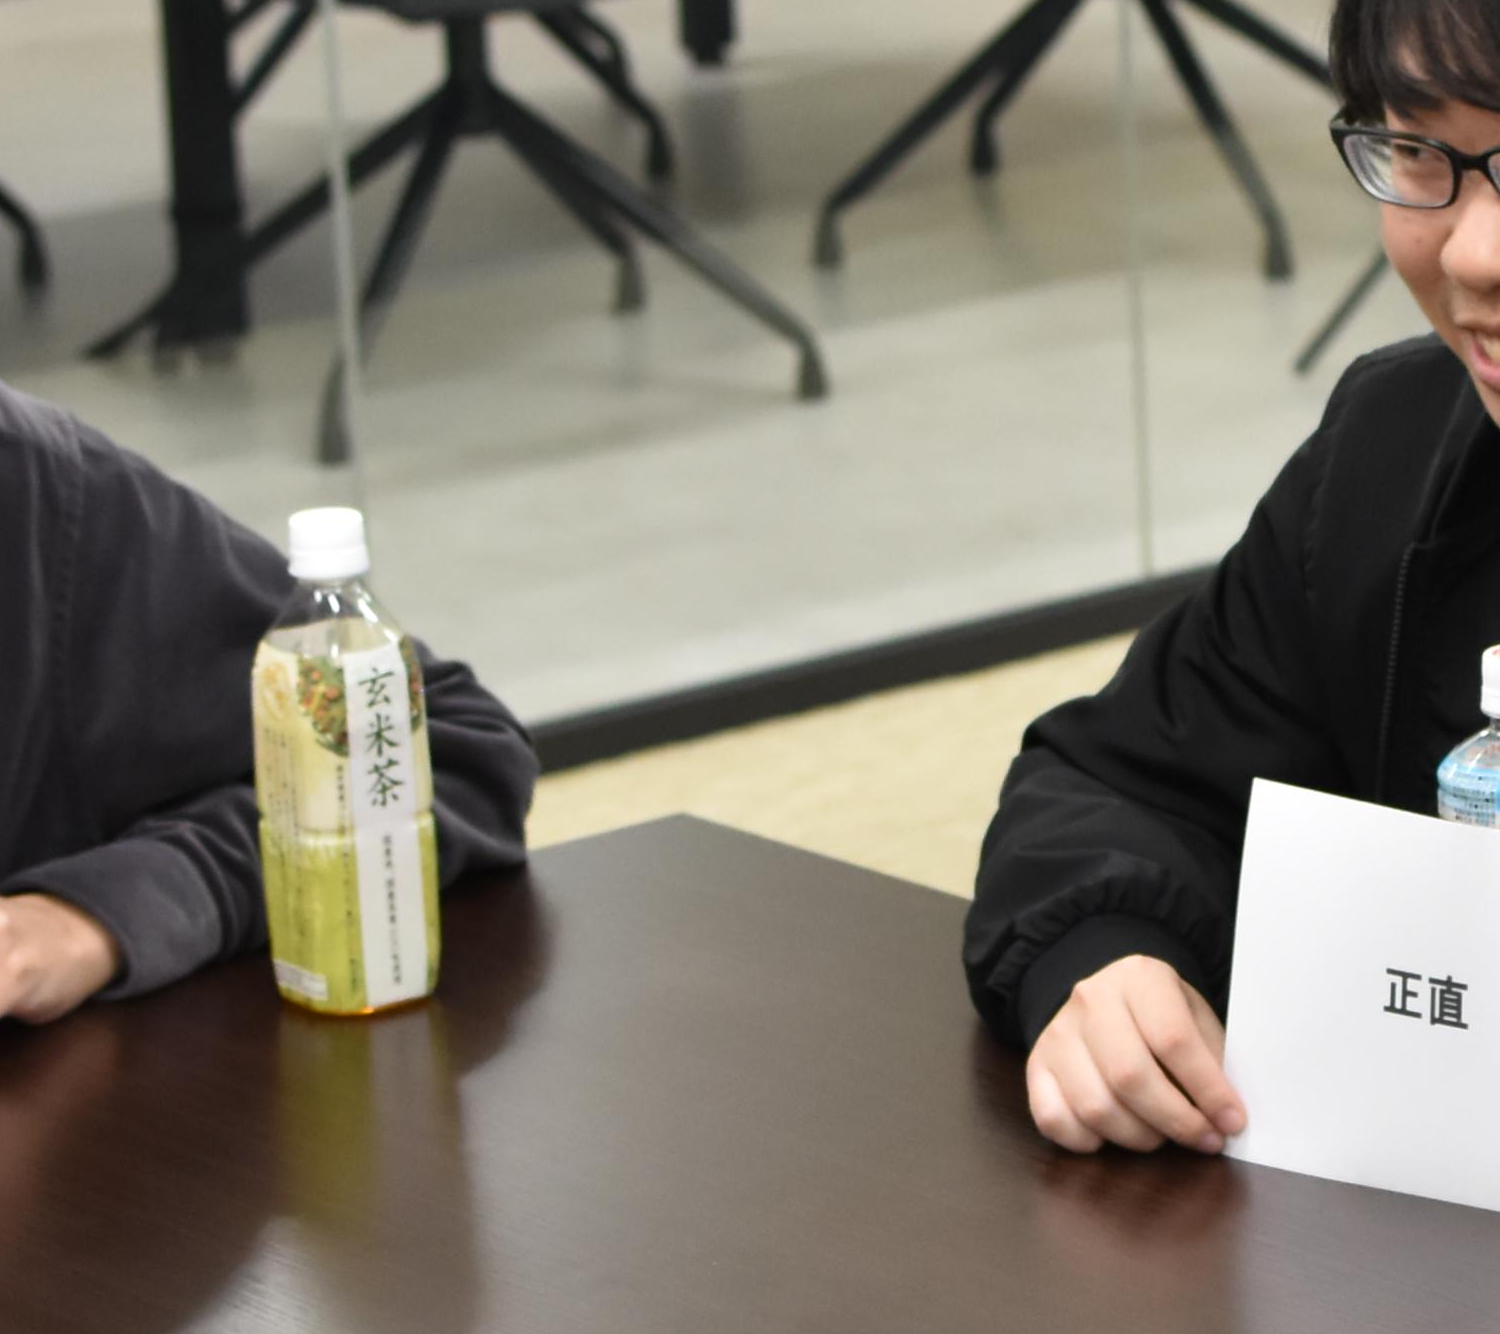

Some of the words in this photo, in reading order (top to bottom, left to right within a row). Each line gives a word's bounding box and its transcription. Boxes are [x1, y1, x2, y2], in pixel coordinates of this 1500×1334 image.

[358, 667, 404, 807] 玄米茶
[1383, 967, 1469, 1030] 正直
